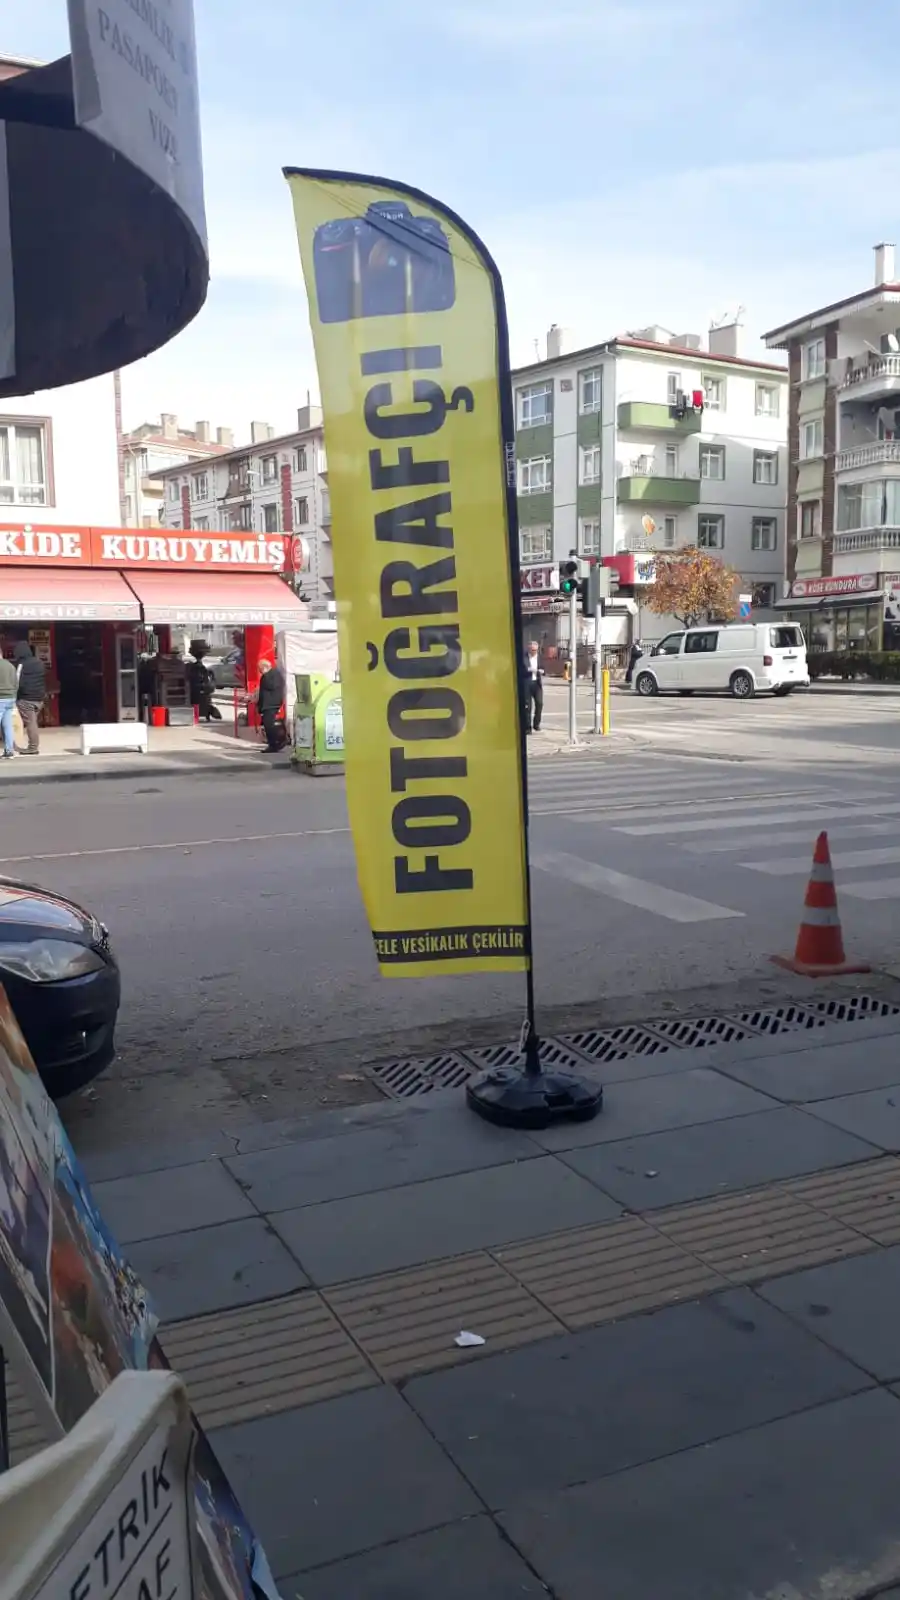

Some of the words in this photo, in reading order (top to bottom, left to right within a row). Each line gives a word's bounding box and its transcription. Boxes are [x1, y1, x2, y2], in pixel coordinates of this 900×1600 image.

[101, 534, 286, 572] KURUYEMİŞ
[359, 345, 475, 894] FOTOĞRAFÇI
[402, 933, 469, 955] VESİKALIK
[472, 928, 524, 954] ÇEKİLİR
